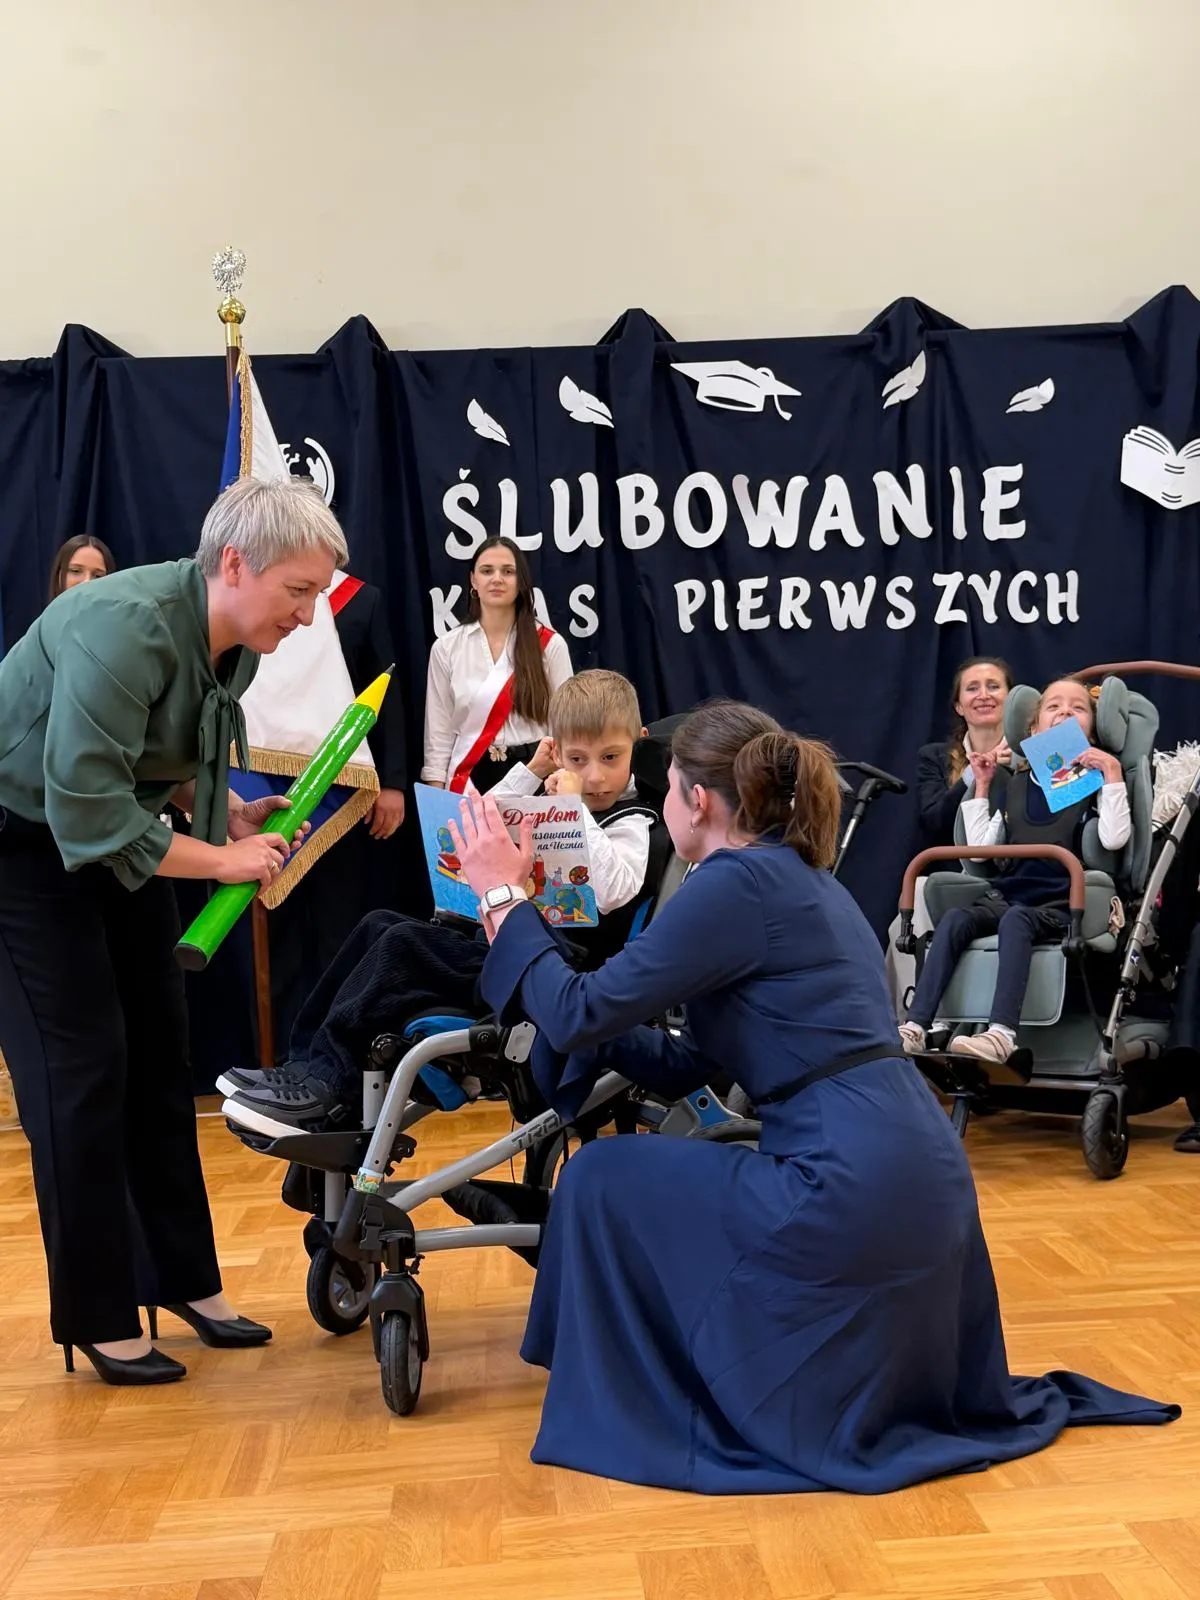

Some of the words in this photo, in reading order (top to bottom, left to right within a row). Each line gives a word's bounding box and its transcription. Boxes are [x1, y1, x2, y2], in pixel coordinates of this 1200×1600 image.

[442, 463, 1026, 560] ŚLUBOWANIE
[674, 570, 1080, 633] PIERWSZYCH
[503, 806, 580, 828] Dplom
[537, 843, 549, 851] na
[549, 841, 584, 851] Ucznia
